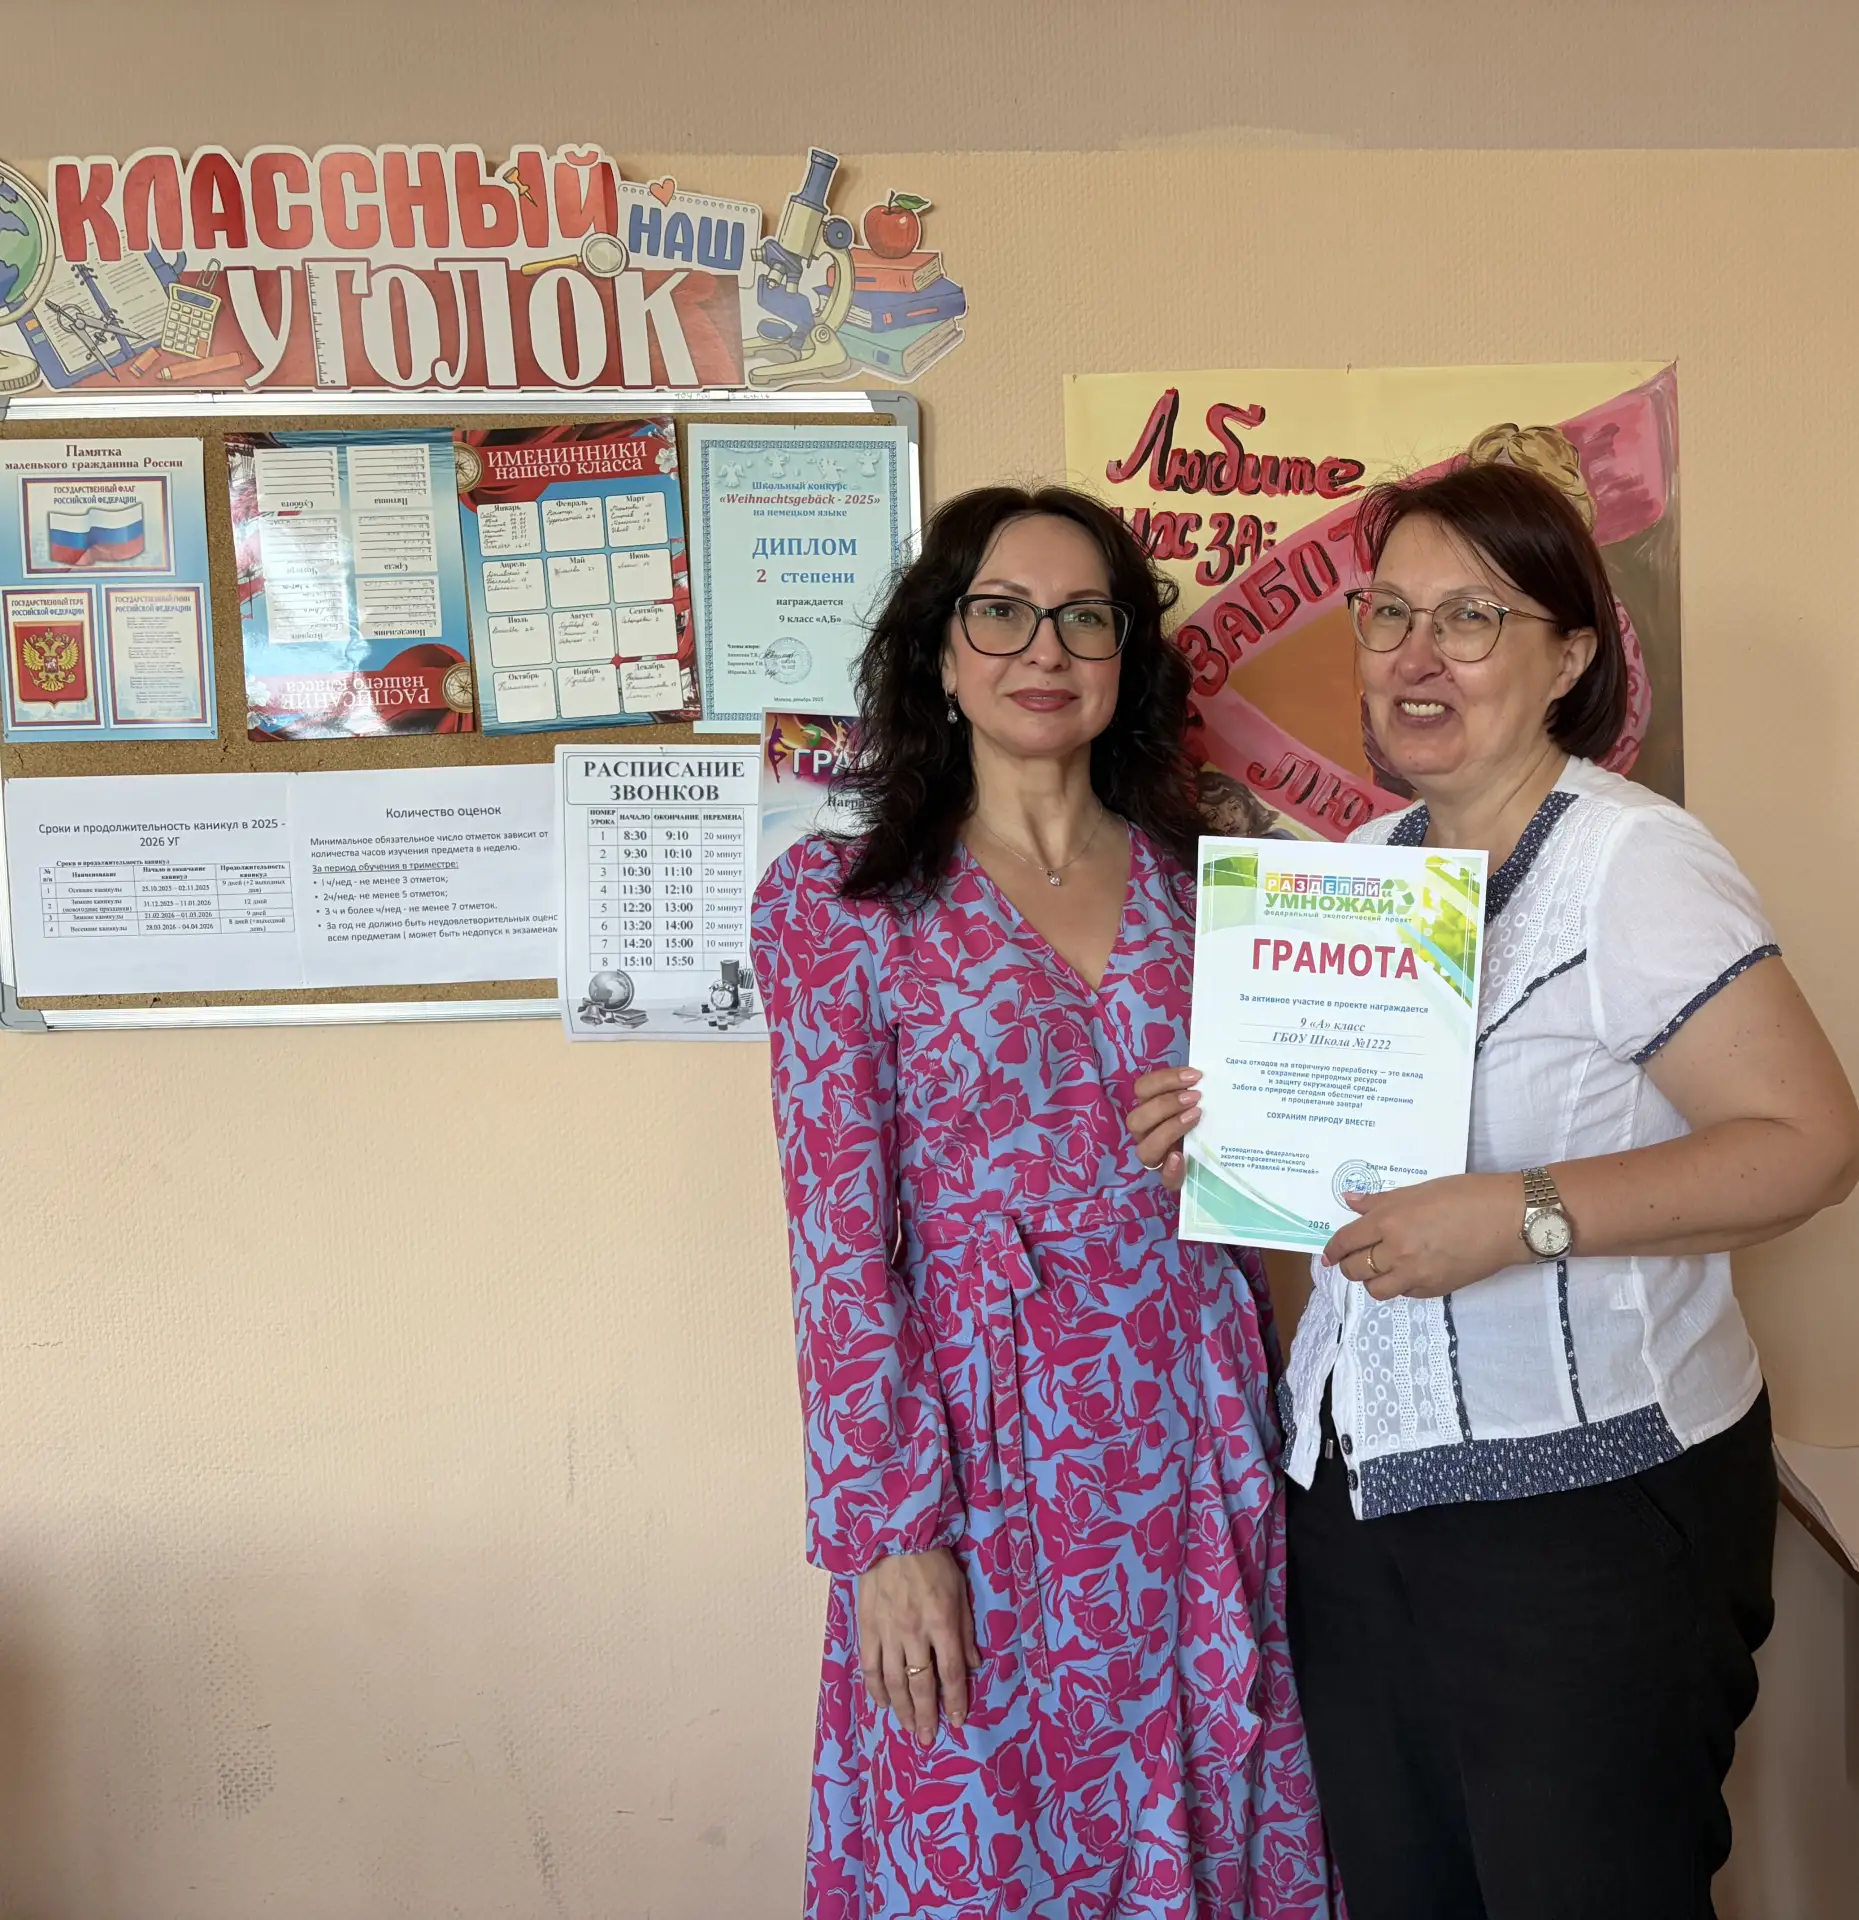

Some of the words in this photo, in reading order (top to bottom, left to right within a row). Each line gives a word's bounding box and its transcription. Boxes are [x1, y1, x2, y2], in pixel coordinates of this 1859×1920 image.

[55, 150, 617, 262] КЛАССНЫЙ
[629, 203, 745, 271] НАШ
[226, 259, 700, 388] УГОЛОК
[1106, 387, 1366, 497] Любите
[66, 444, 122, 458] Памятка
[487, 441, 648, 468] ИМЕНИННИКИ
[5, 461, 68, 471] маленького
[72, 459, 139, 471] гражданина
[143, 457, 183, 469] России
[495, 461, 571, 480] нашего
[577, 458, 643, 475] класса
[53, 485, 117, 495] ГОСУДАРСТВЕННЫЙ
[118, 485, 137, 494] ФЛАГ
[752, 481, 806, 491] Школьный
[807, 482, 848, 493] конкурс
[53, 495, 96, 505] РОССИЙСКОЙ
[97, 495, 137, 505] ФЕДЕРАЦИИ
[374, 496, 409, 506] Пятница
[626, 495, 645, 503] Март
[719, 493, 835, 508] «Weihnachtsgebäck
[844, 494, 881, 506] 2025»
[281, 500, 313, 510] Суббота
[494, 504, 521, 513] Январь
[556, 500, 588, 509] Февраль
[753, 509, 765, 517] на
[767, 509, 816, 518] немецком
[817, 509, 848, 517] языке
[752, 537, 858, 559] ДИПЛОМ
[570, 556, 586, 564] Май
[630, 552, 650, 560] Июнь
[384, 562, 409, 571] Среда
[500, 562, 527, 570] Апрель
[756, 568, 767, 583] 2
[780, 571, 855, 585] степени
[11, 598, 68, 608] ГОСУДАРСТВЕННЫЙ
[69, 598, 84, 607] ГЕРБ
[115, 603, 154, 613] РОССИЙСКОЙ
[155, 603, 192, 613] ФЕДЕРАЦИИ
[776, 598, 844, 608] награждается
[11, 607, 49, 617] РОССИЙСКОЙ
[49, 607, 85, 617] ФЕДЕРАЦИИ
[629, 606, 664, 616] Сентябрь
[508, 616, 529, 624] Июль
[570, 612, 594, 621] Август
[778, 615, 785, 623] 9
[787, 615, 814, 623] класс
[815, 614, 842, 624] «А,Б»
[374, 628, 426, 638] Понедельник
[573, 667, 601, 677] Ноябрь
[634, 662, 666, 672] Декабрь
[508, 672, 540, 682] Октябрь
[285, 678, 347, 693] класса
[353, 676, 425, 693] нашего
[280, 687, 431, 710] РАСПИСАНИЕ
[584, 761, 745, 778] РАСПИСАНИЕ
[610, 784, 720, 801] ЗВОНКОВ
[386, 807, 455, 819] Количество
[457, 806, 502, 818] оценок
[38, 823, 71, 835] Сроки
[83, 822, 191, 834] продолжительность
[194, 820, 239, 832] каникул
[242, 821, 249, 829] в
[251, 818, 278, 829] 2025
[591, 818, 615, 826] УРОКА
[310, 837, 373, 846] Минимальное
[375, 835, 435, 844] обязательное
[437, 834, 463, 842] число
[466, 833, 501, 841] отметок
[504, 831, 536, 839] зависит
[624, 831, 647, 841] 8:30
[665, 831, 689, 841] 9:10
[139, 837, 165, 847] 2026
[167, 836, 181, 846] УГ
[311, 849, 360, 858] количества
[362, 848, 386, 856] часов
[388, 847, 429, 857] изучения
[431, 845, 474, 855] предмета
[484, 844, 521, 853] неделю.
[624, 849, 647, 859] 9:30
[664, 849, 692, 859] 10:10
[312, 864, 322, 873] За
[324, 864, 357, 873] период
[358, 862, 400, 872] обучения
[622, 866, 651, 876] 10:30
[664, 866, 693, 876] 11:10
[623, 884, 651, 894] 11:30
[665, 884, 693, 894] 12:10
[1265, 874, 1381, 897] РАЗДЕЛЯЙ
[180, 899, 212, 907] 11.01.2026
[623, 902, 652, 912] 12:20
[665, 902, 693, 912] 13:00
[1263, 909, 1319, 918] федеральный
[1322, 912, 1382, 922] экологический
[1385, 916, 1412, 924] проект
[623, 920, 652, 930] 13:20
[665, 920, 694, 930] 14:00
[623, 938, 652, 948] 14:20
[665, 938, 694, 948] 15:00
[624, 956, 653, 966] 15:10
[666, 956, 694, 966] 15:50
[1252, 938, 1419, 980] ГРАМОТА
[1239, 993, 1250, 1002] За
[1251, 995, 1290, 1005] активное
[1292, 997, 1325, 1007] участие
[1334, 1001, 1367, 1011] проекте
[1369, 1003, 1429, 1014] награждается
[1299, 1017, 1307, 1028] 9
[1309, 1018, 1331, 1029] «А»
[1334, 1021, 1366, 1032] класс
[1272, 1031, 1308, 1044] ГБОУ
[1309, 1034, 1350, 1047] Школа
[1352, 1037, 1392, 1050] №1222
[1231, 1083, 1257, 1092] Забота
[1265, 1086, 1296, 1095] природе
[1297, 1088, 1326, 1098] сегодня
[1327, 1090, 1365, 1100] обеспечит
[1366, 1093, 1375, 1101] её
[1376, 1095, 1414, 1105] гармонию
[1266, 1111, 1307, 1122] СОХРАНИМ
[1308, 1114, 1344, 1126] ПРИРОДУ
[1345, 1118, 1376, 1128] ВМЕСТЕ!
[1365, 1161, 1388, 1172] Елена
[1389, 1164, 1428, 1176] Белоусова
[1308, 1219, 1330, 1230] 2026
